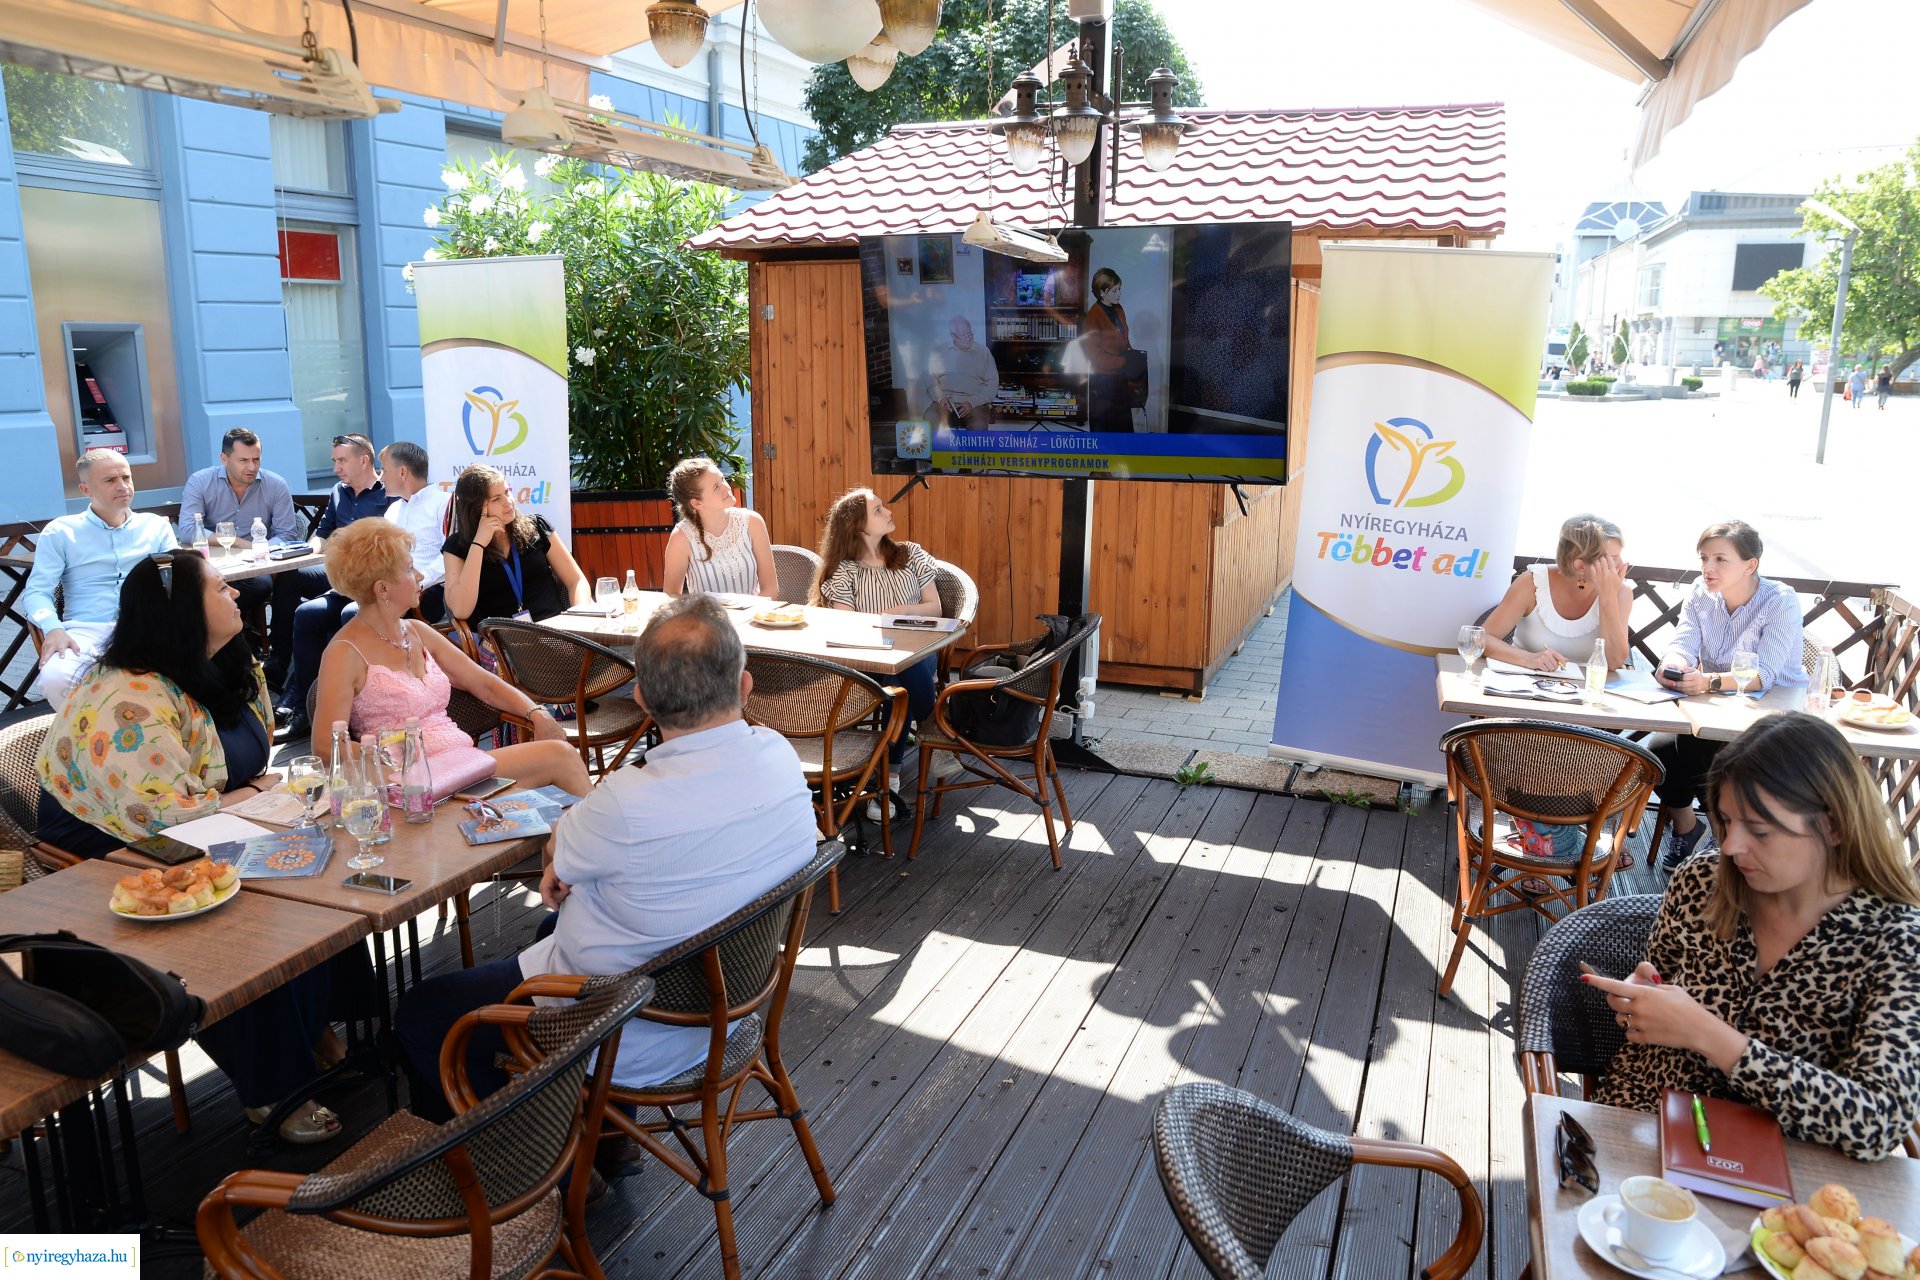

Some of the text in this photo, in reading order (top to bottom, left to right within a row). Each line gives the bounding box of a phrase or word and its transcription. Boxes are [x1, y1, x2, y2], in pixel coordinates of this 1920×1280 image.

[949, 434, 995, 448] KARINTHY
[998, 434, 1038, 449] SZÍNHÁZ
[1050, 434, 1099, 450] LÖKÖTTEK
[951, 454, 1109, 470] SZÍNHÁZI VERSENYPROGRAMOK
[517, 480, 551, 505] ad!
[1340, 512, 1468, 542] NYÍREGYHÁZA
[1316, 531, 1490, 579] Többet ad!
